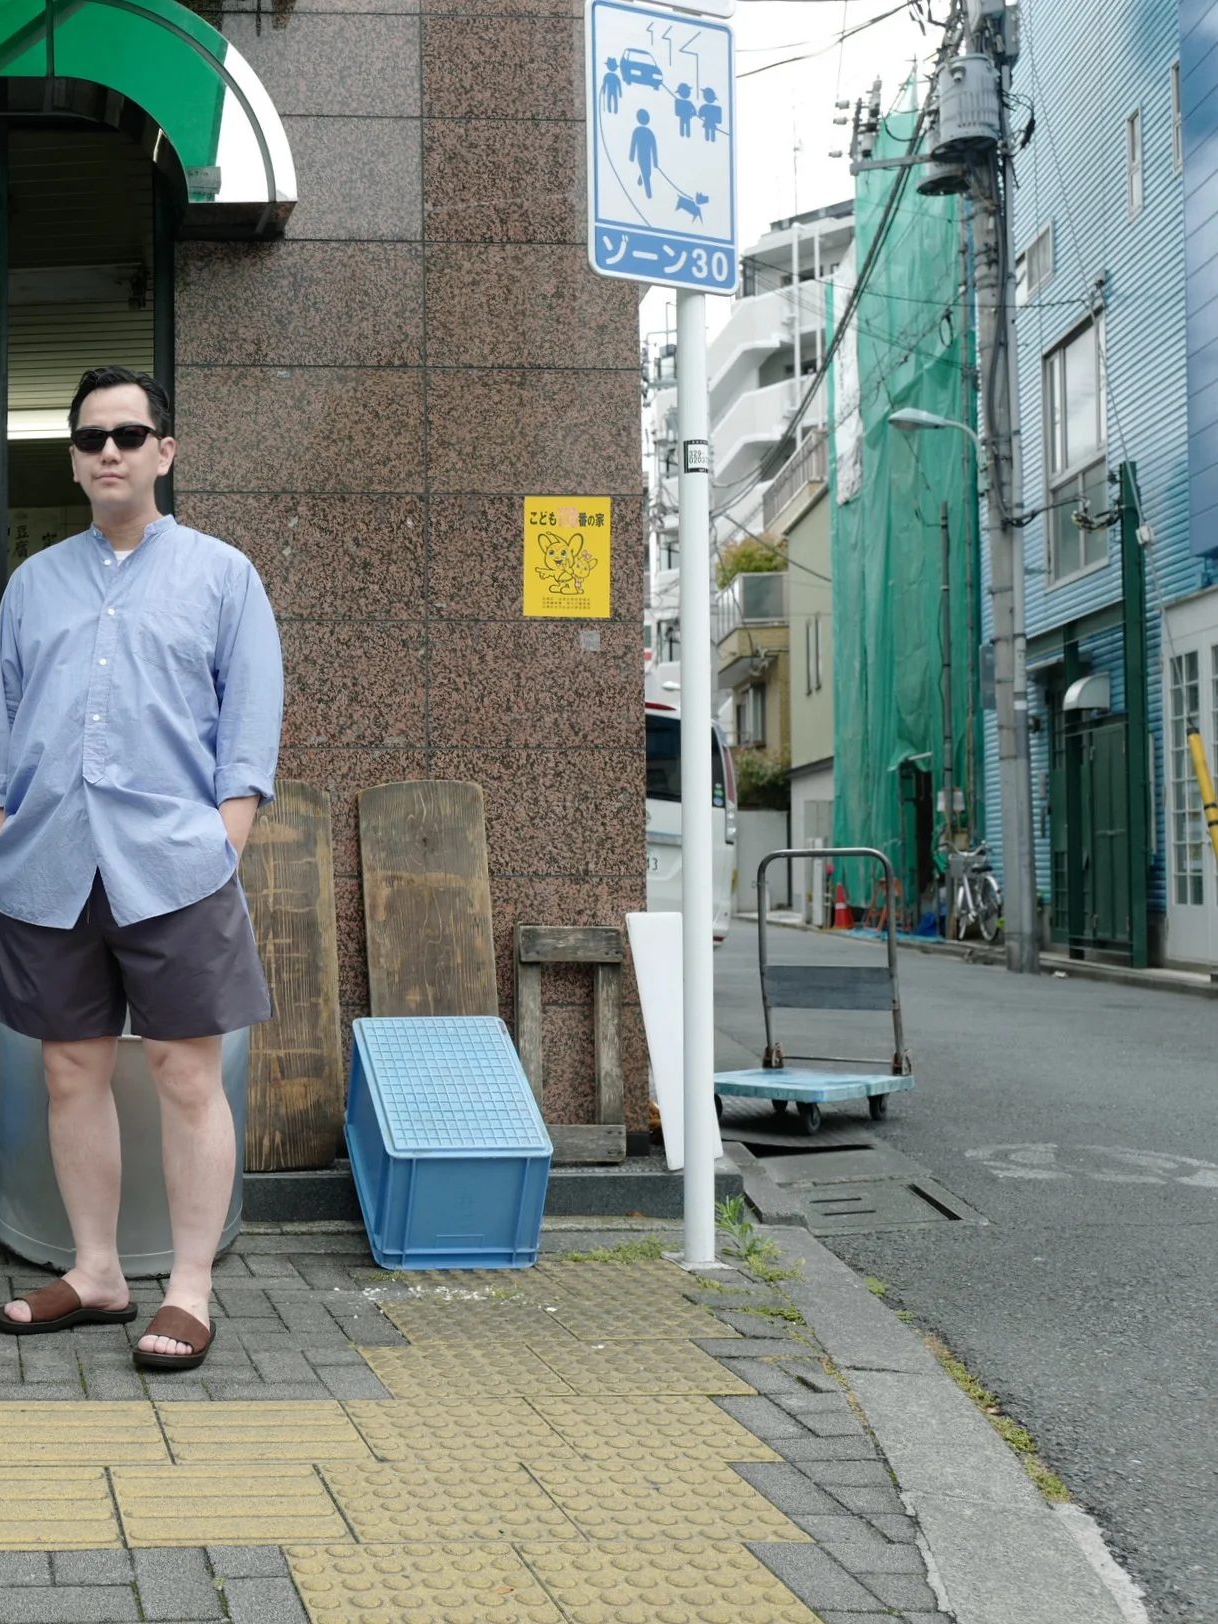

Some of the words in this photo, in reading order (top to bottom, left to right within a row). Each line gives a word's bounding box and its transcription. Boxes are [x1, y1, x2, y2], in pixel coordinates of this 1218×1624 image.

[602, 234, 729, 282] ゾーン30
[529, 506, 605, 528] こども110番の家
